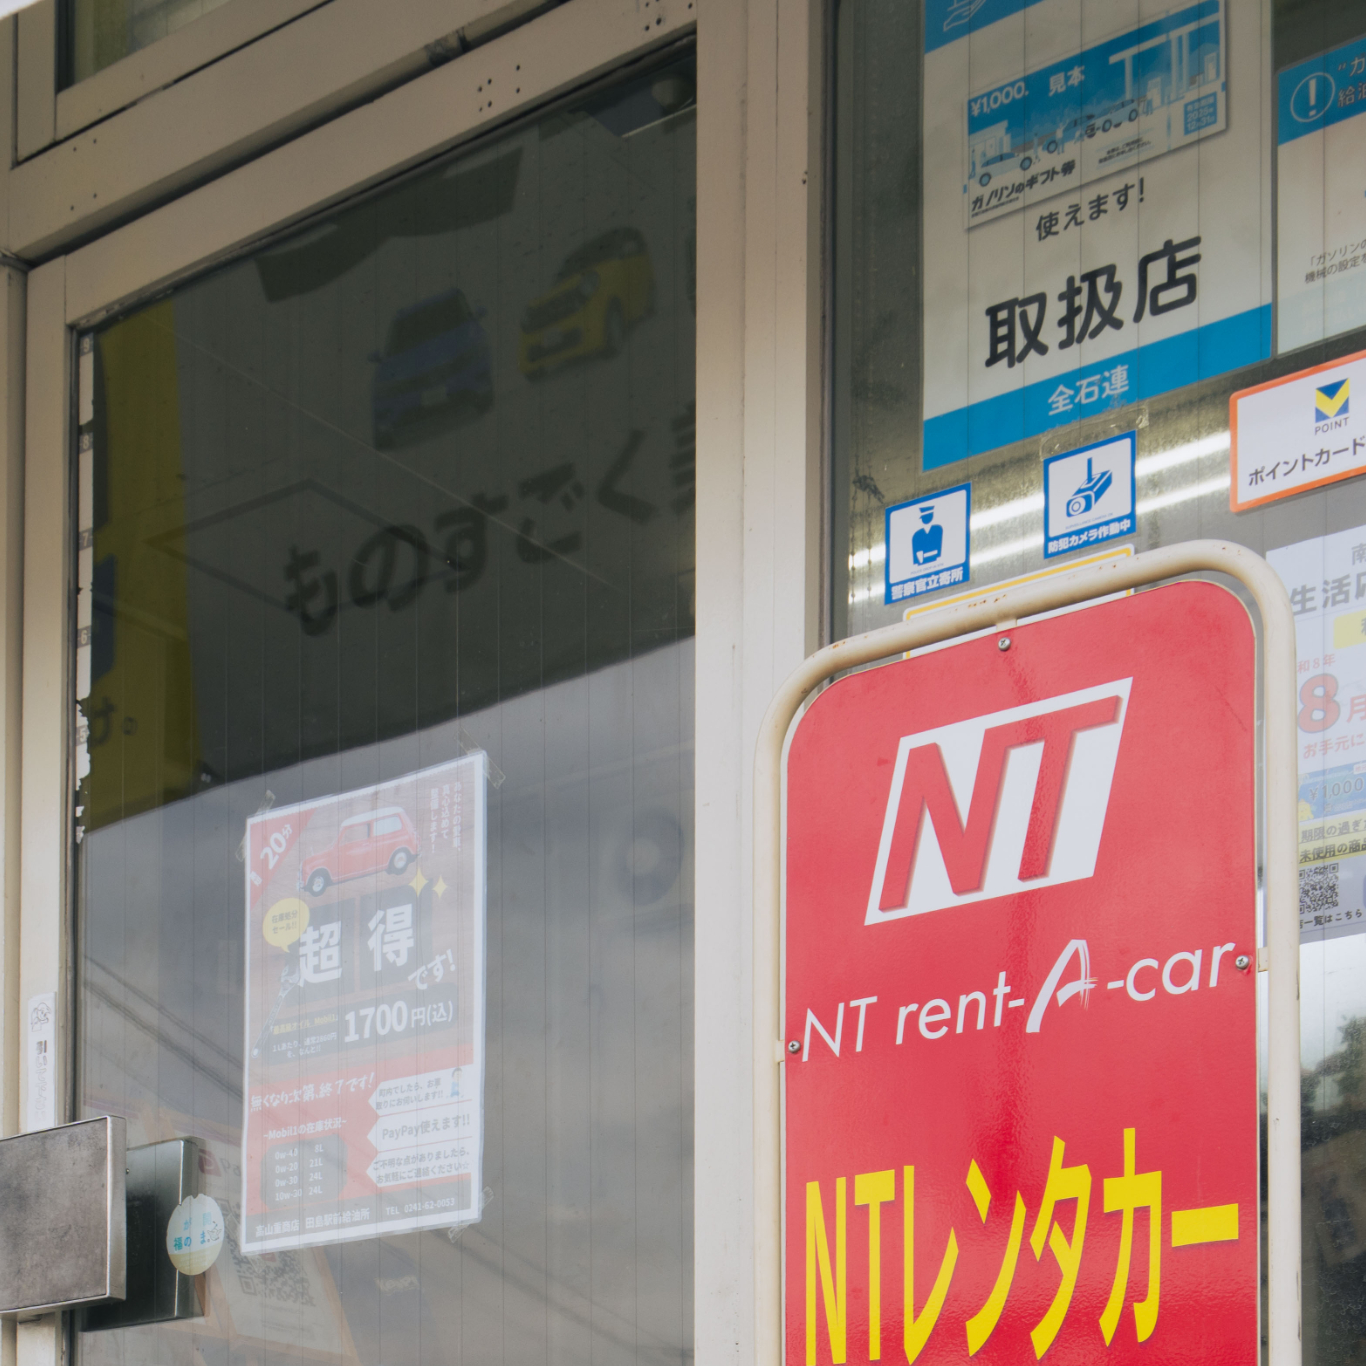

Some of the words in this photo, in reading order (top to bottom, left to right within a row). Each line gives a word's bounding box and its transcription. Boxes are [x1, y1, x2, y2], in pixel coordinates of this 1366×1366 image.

[1048, 65, 1086, 97] 見本
[1035, 177, 1145, 242] 使えます!
[985, 234, 1203, 370] 取扱店
[1047, 365, 1131, 418] 全石連
[1313, 416, 1350, 435] POINT
[1048, 519, 1131, 554] 防犯カメラ作動中
[891, 566, 964, 600] 警察官立寄所
[878, 694, 1124, 914] NT
[271, 909, 298, 924] 在庫処分
[407, 948, 456, 991] です!
[800, 996, 878, 1063] NT
[381, 1113, 471, 1140] PayPay使えます!!
[309, 1158, 323, 1168] 21L
[314, 1144, 324, 1154] 8L
[308, 1171, 323, 1182] 24L
[308, 1185, 323, 1196] 24L
[305, 1207, 371, 1230] 田島駅前給油所
[385, 1206, 400, 1216] TEL
[403, 1197, 456, 1214] 0241-62-0053
